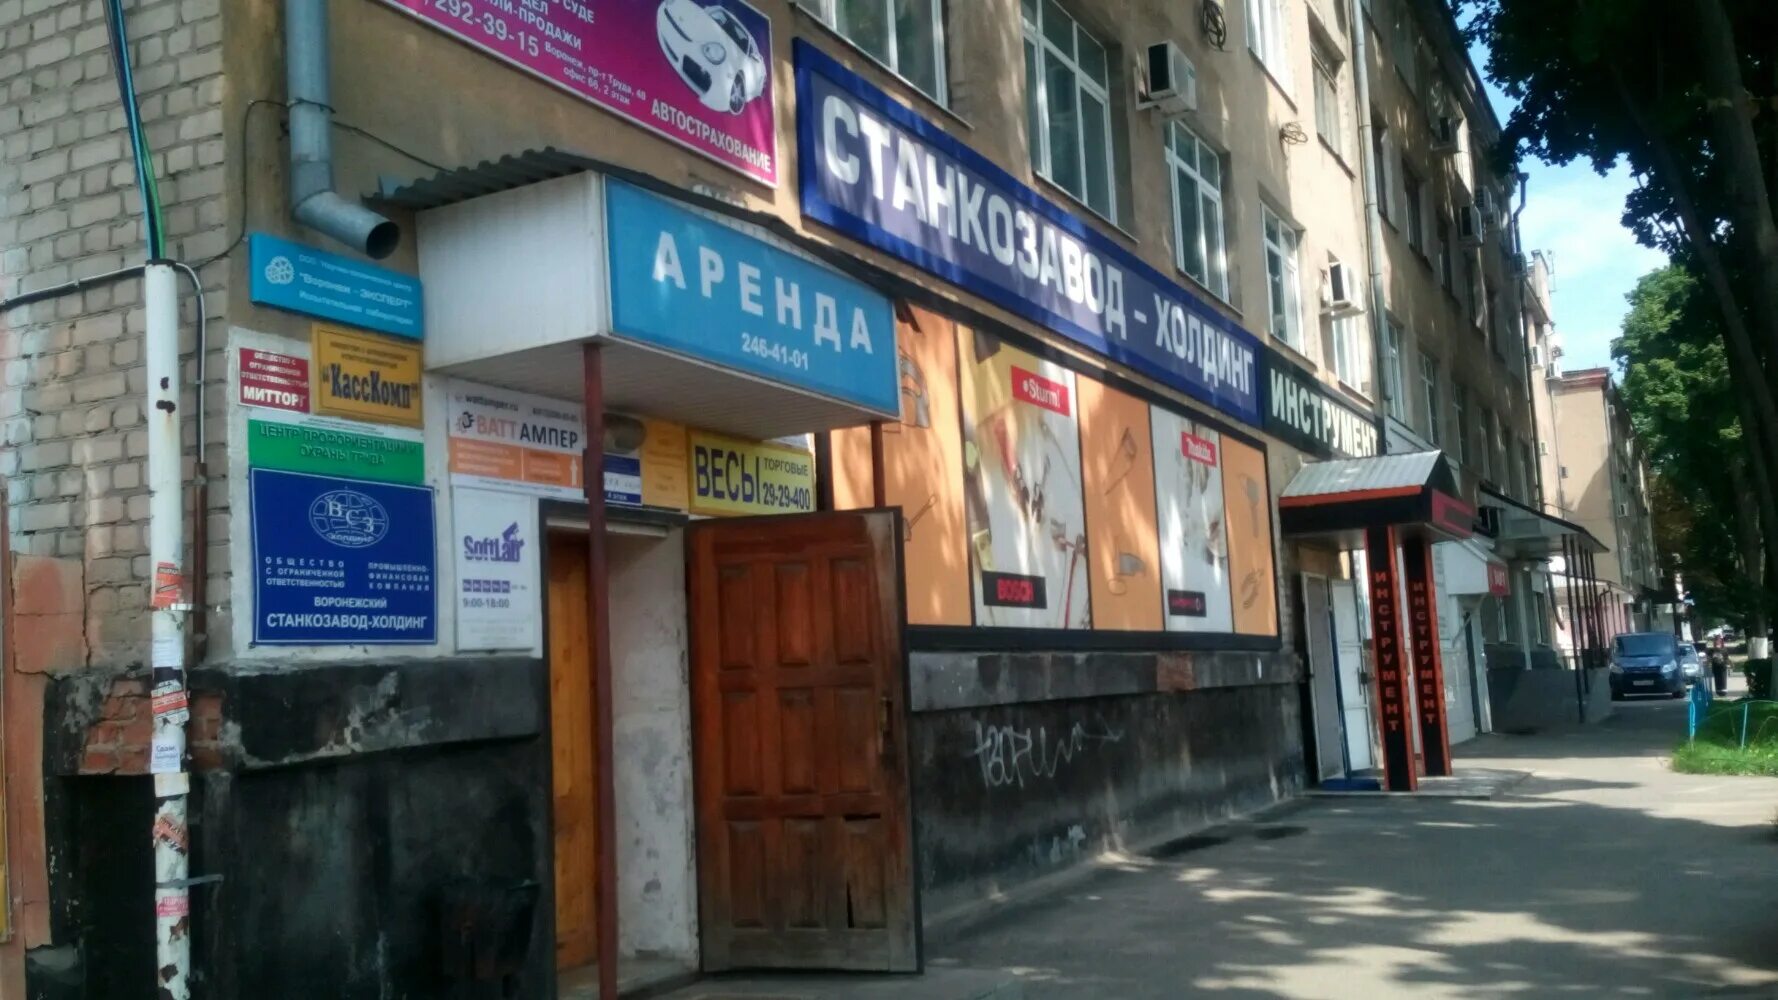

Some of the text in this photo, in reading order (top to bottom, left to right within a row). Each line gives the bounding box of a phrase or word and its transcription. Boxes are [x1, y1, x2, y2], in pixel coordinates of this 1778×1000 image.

[487, 0, 582, 50] ЛИ-ПРОДАЖИ
[603, 85, 610, 95] 2
[651, 99, 773, 173] АВТОСТРАХОВАНИЕ
[821, 95, 1127, 340] СТАНКОЗАВОД
[1153, 293, 1254, 396] ХОЛДИНГ
[652, 231, 873, 354] АРЕНДА
[741, 332, 809, 371] 246-41-01
[1270, 368, 1379, 458] ИНСТРУМЕНТ
[695, 445, 760, 504] ВЕСЫ
[763, 457, 808, 477] ТОРГОВЫЕ
[762, 481, 811, 511] 29-29-400
[265, 556, 345, 568] ОБЩЕСТВО
[266, 577, 345, 588] ОТВЕТСТВЕННОСТЬЮ
[277, 568, 345, 577] ОГРАНИЧЕННОЙ
[266, 613, 428, 630] СТАНКОЗАВОД-ХОЛДИНГ
[314, 597, 387, 609] ВОРОНЕЖСКИЙ
[1375, 572, 1399, 732] ИНСТРУМЕНТ
[1413, 582, 1436, 725] ИНСТРУМЕНТ
